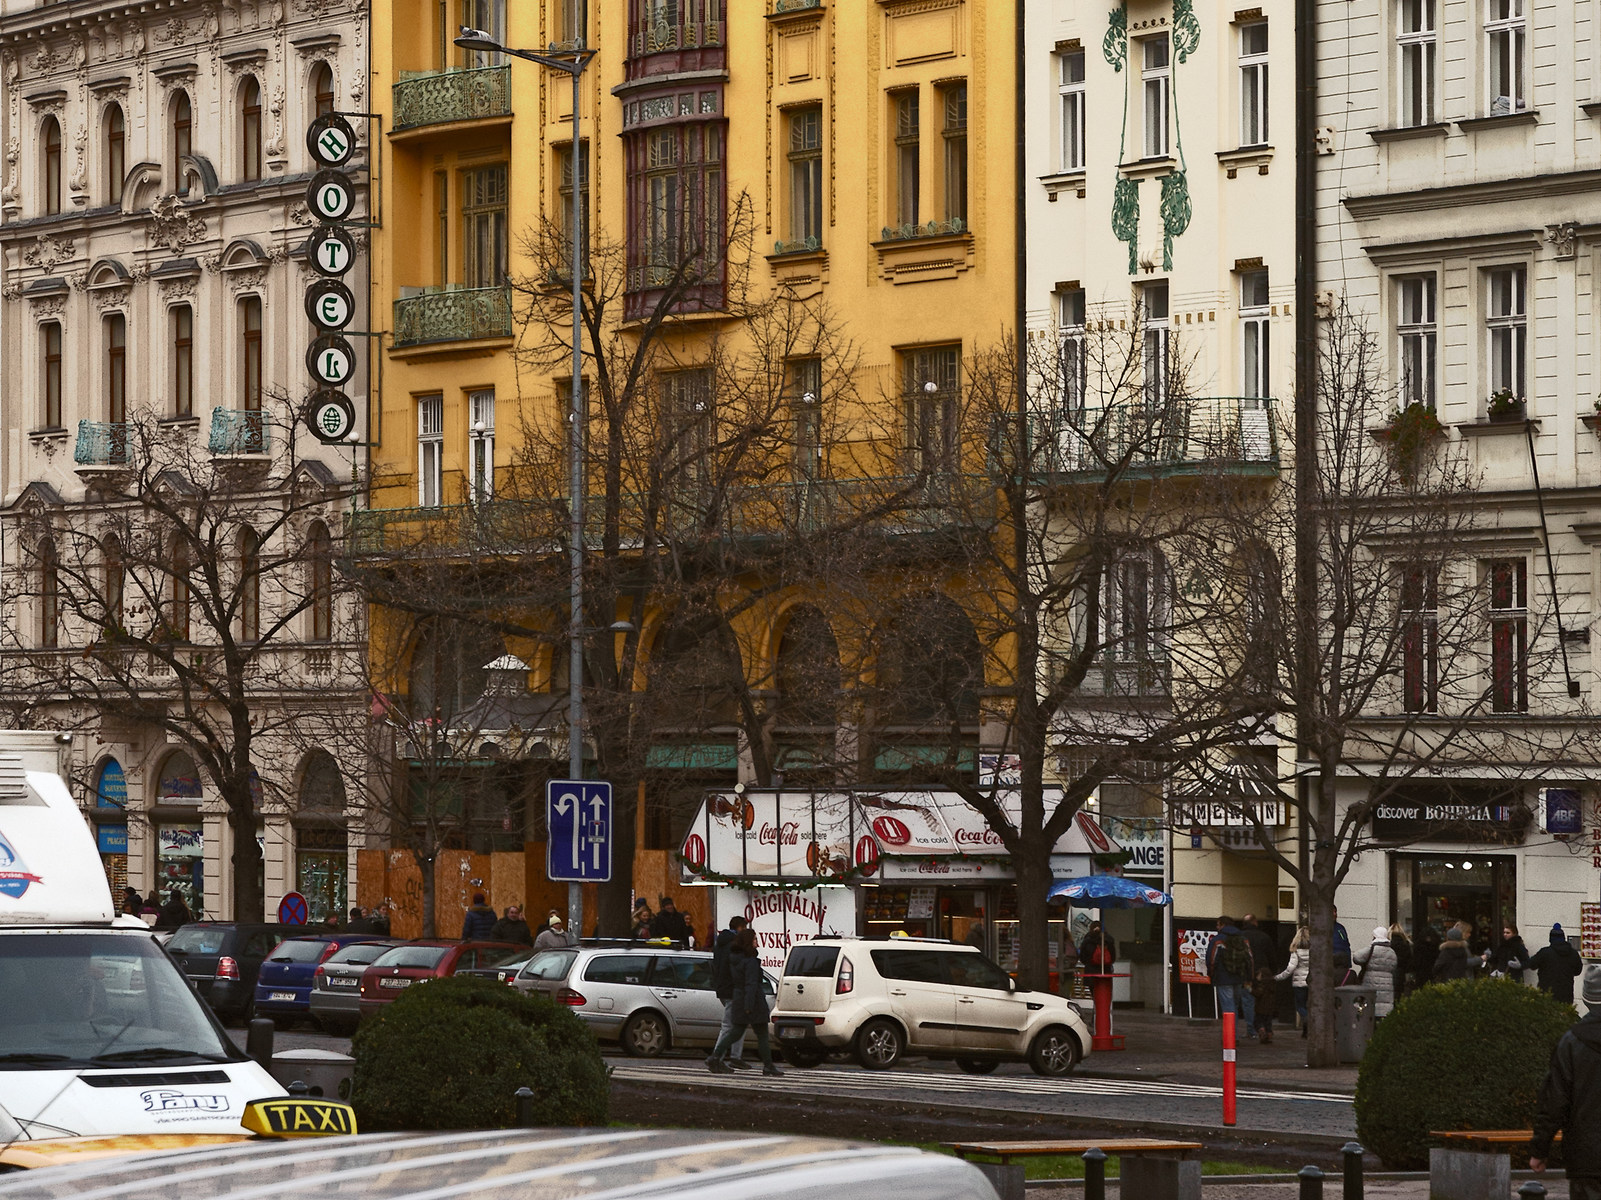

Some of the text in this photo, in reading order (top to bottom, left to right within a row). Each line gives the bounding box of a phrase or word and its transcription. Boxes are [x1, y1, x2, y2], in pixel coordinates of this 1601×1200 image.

[319, 130, 347, 379] HOTEL
[1377, 804, 1419, 819] discover
[1425, 805, 1492, 821] BOHEMIA
[759, 821, 800, 846] CocaCola
[915, 836, 949, 844] Ice cold
[1123, 846, 1164, 866] ANGE
[1181, 957, 1194, 966] City
[270, 1106, 347, 1132] TAXI
